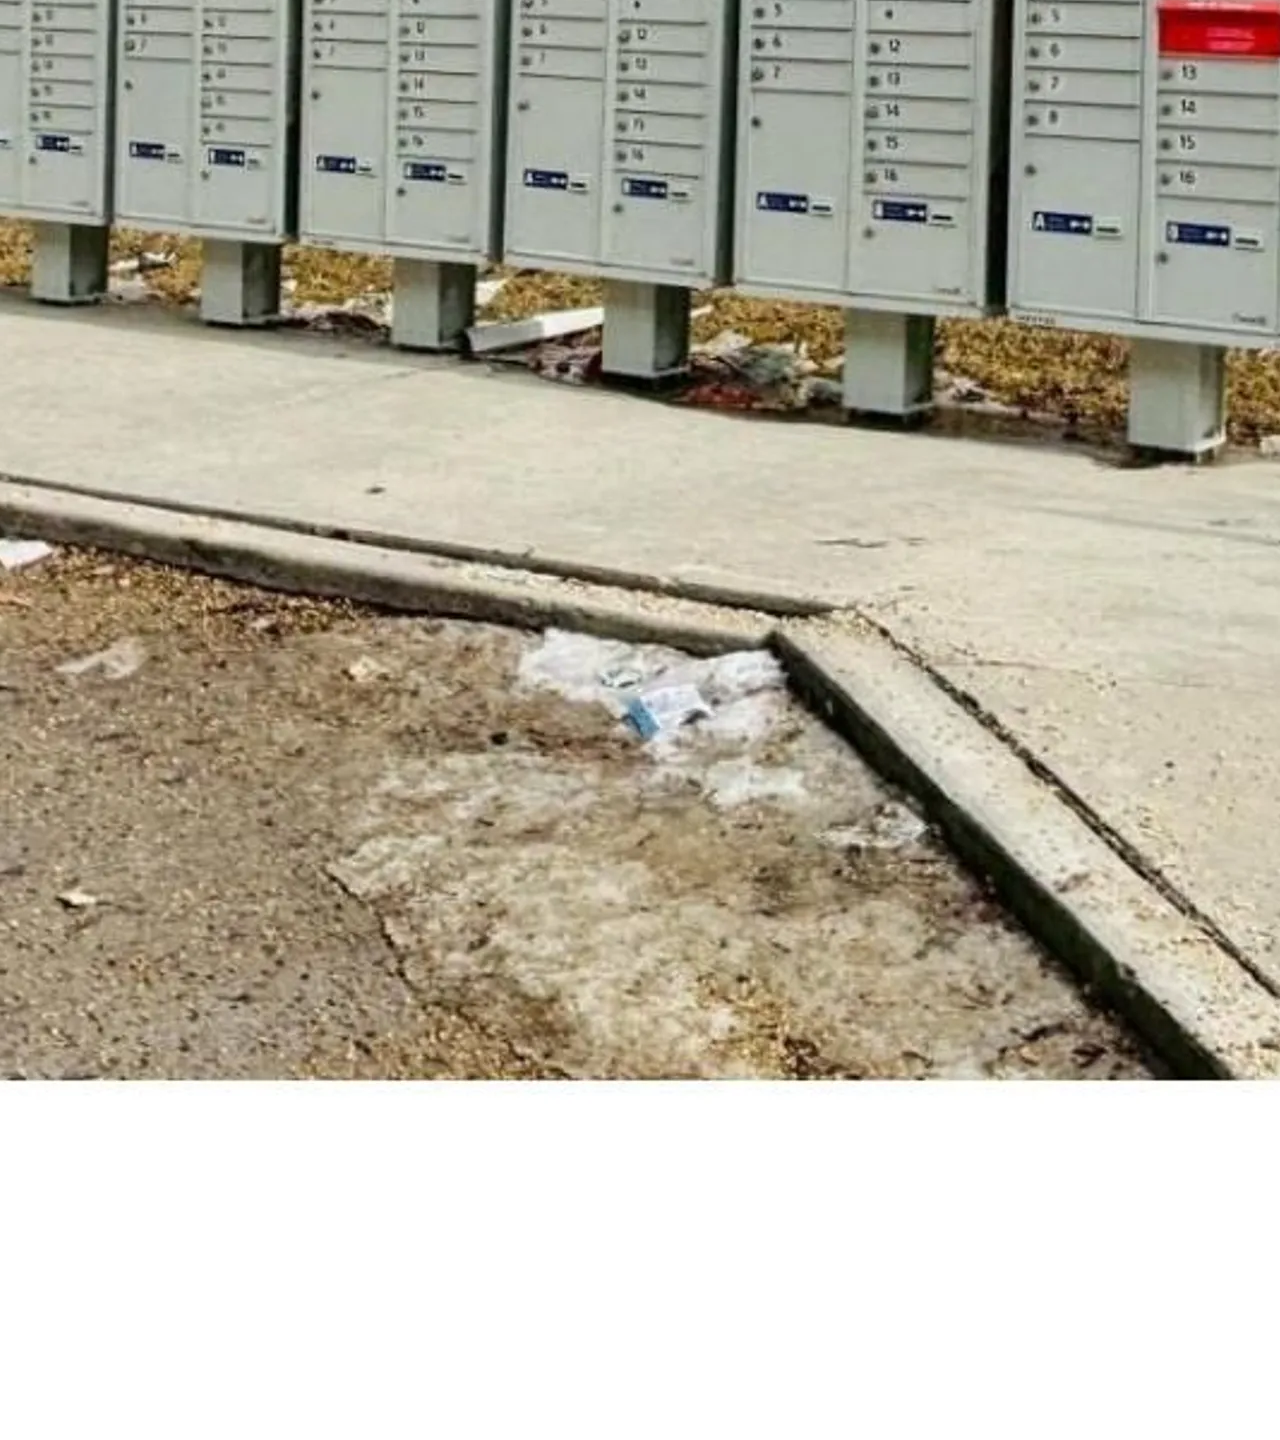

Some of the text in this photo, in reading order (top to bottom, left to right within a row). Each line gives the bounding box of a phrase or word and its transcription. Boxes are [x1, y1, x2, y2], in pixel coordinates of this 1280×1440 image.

[1049, 42, 1061, 58] 6
[1181, 64, 1197, 81] 13
[1051, 75, 1060, 90] 7
[1181, 98, 1196, 114] 14
[1179, 134, 1196, 150] 15
[1179, 170, 1196, 185] 16
[1034, 213, 1046, 231] A
